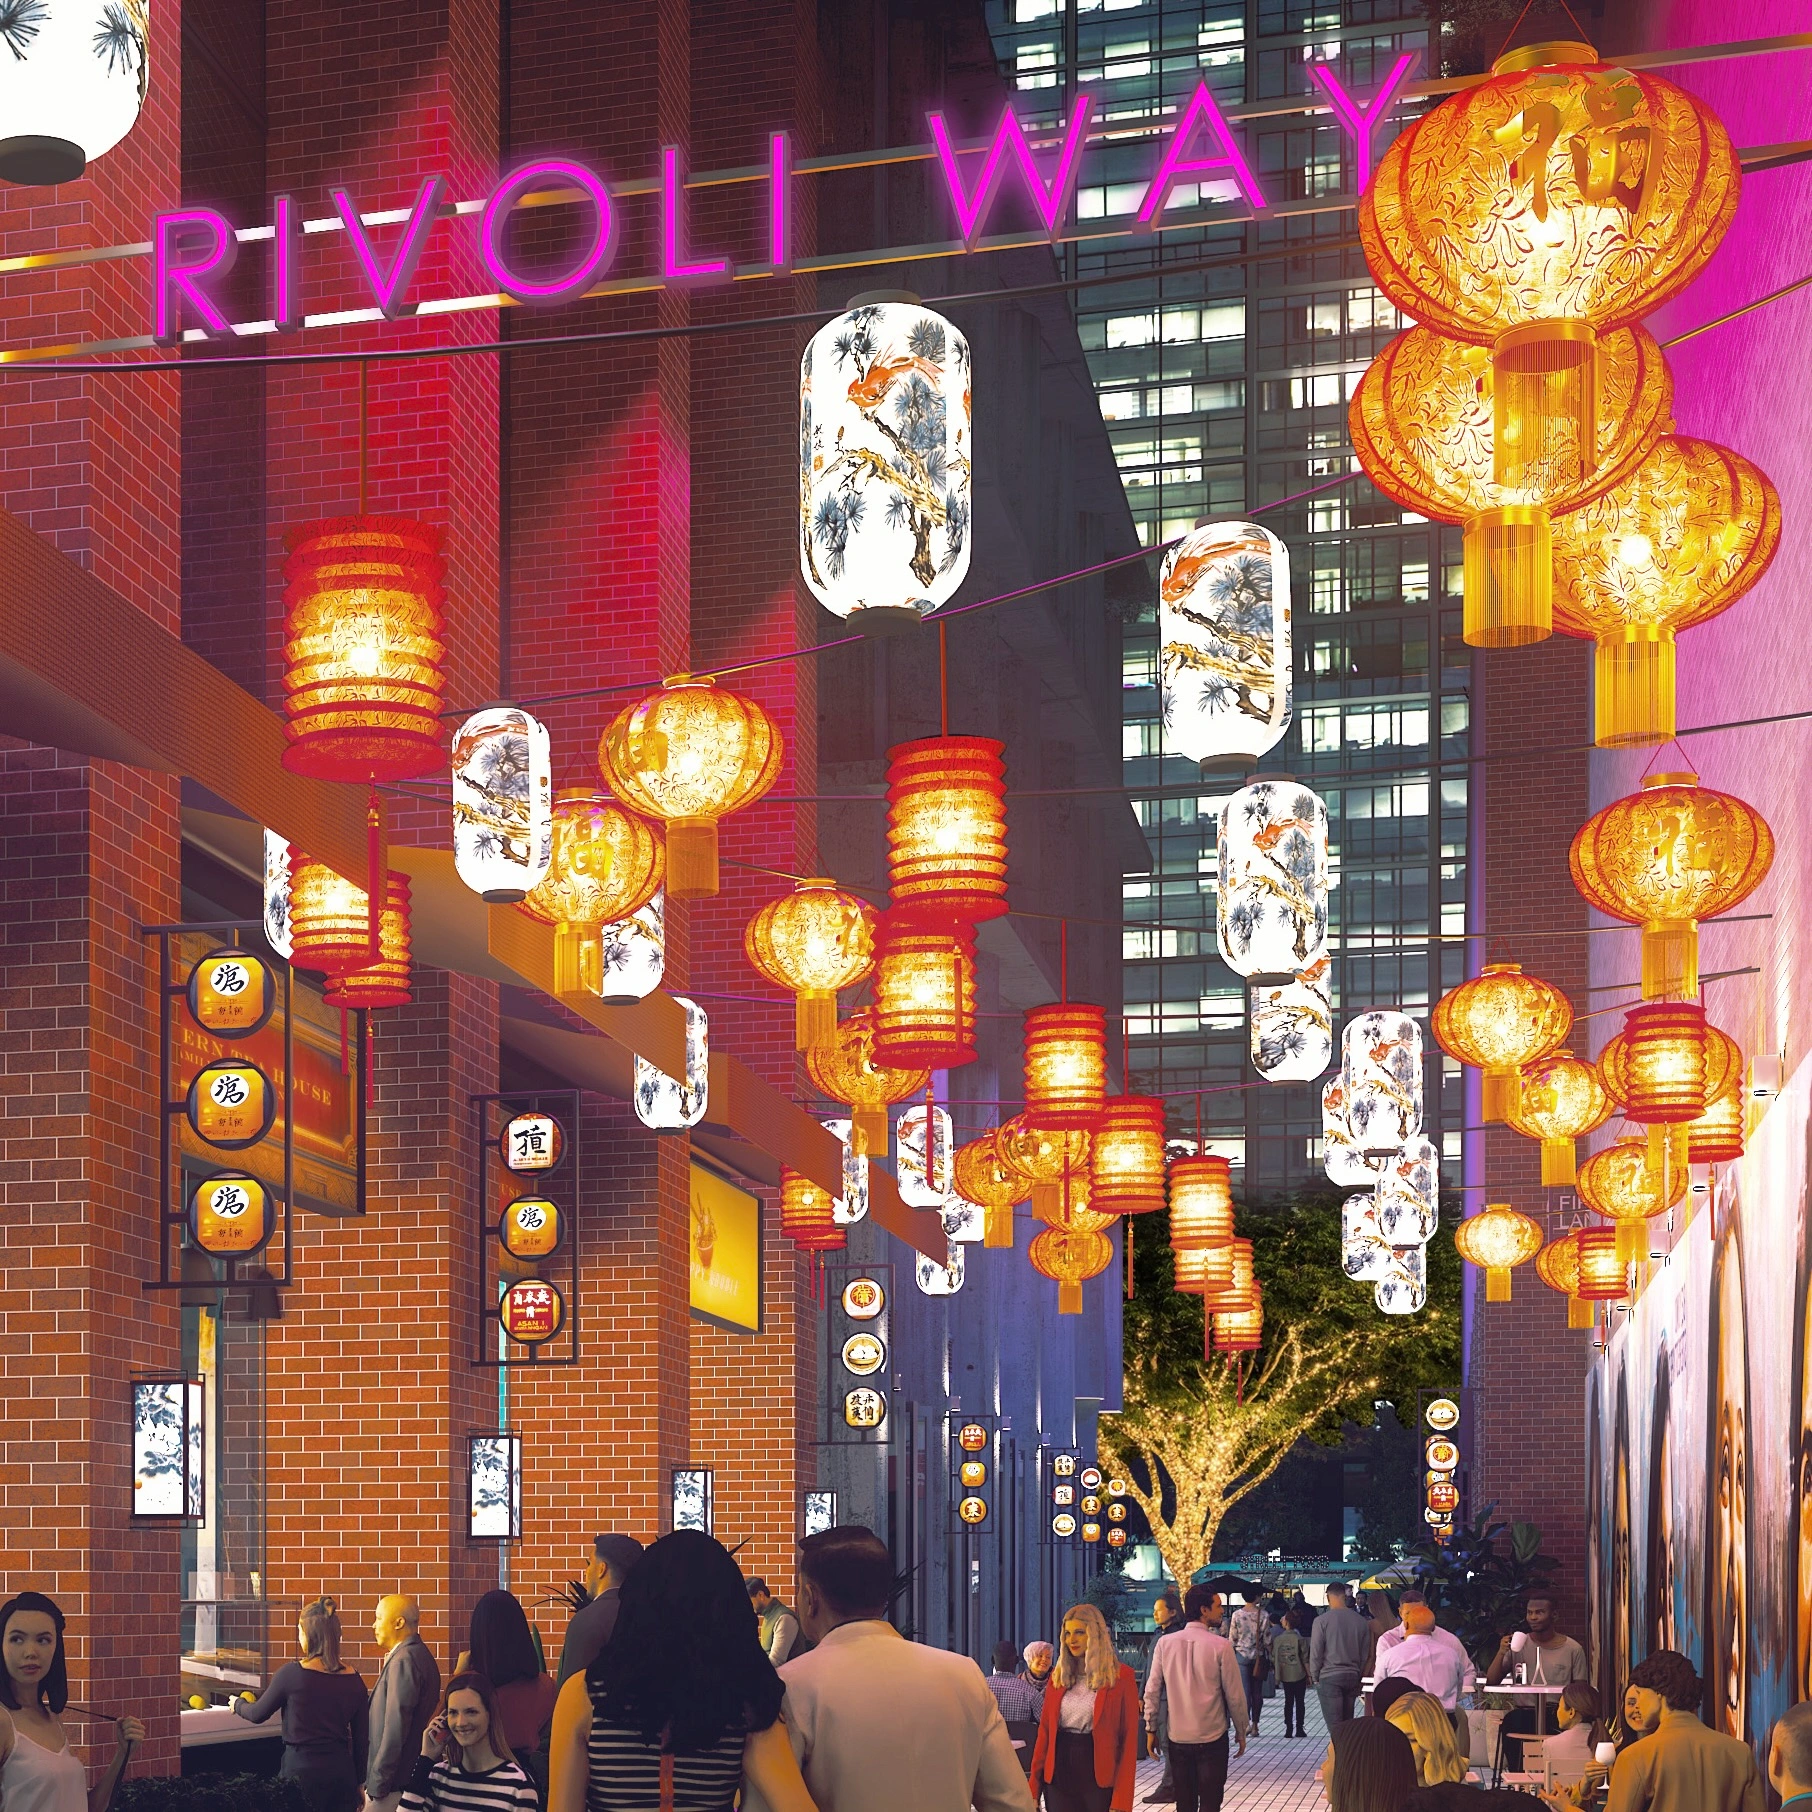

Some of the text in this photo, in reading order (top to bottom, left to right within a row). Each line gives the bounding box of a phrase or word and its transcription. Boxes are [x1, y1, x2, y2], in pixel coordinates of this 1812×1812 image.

[154, 52, 1421, 346] RIVOLI WAY
[1240, 1554, 1330, 1570] STREET FOOD
